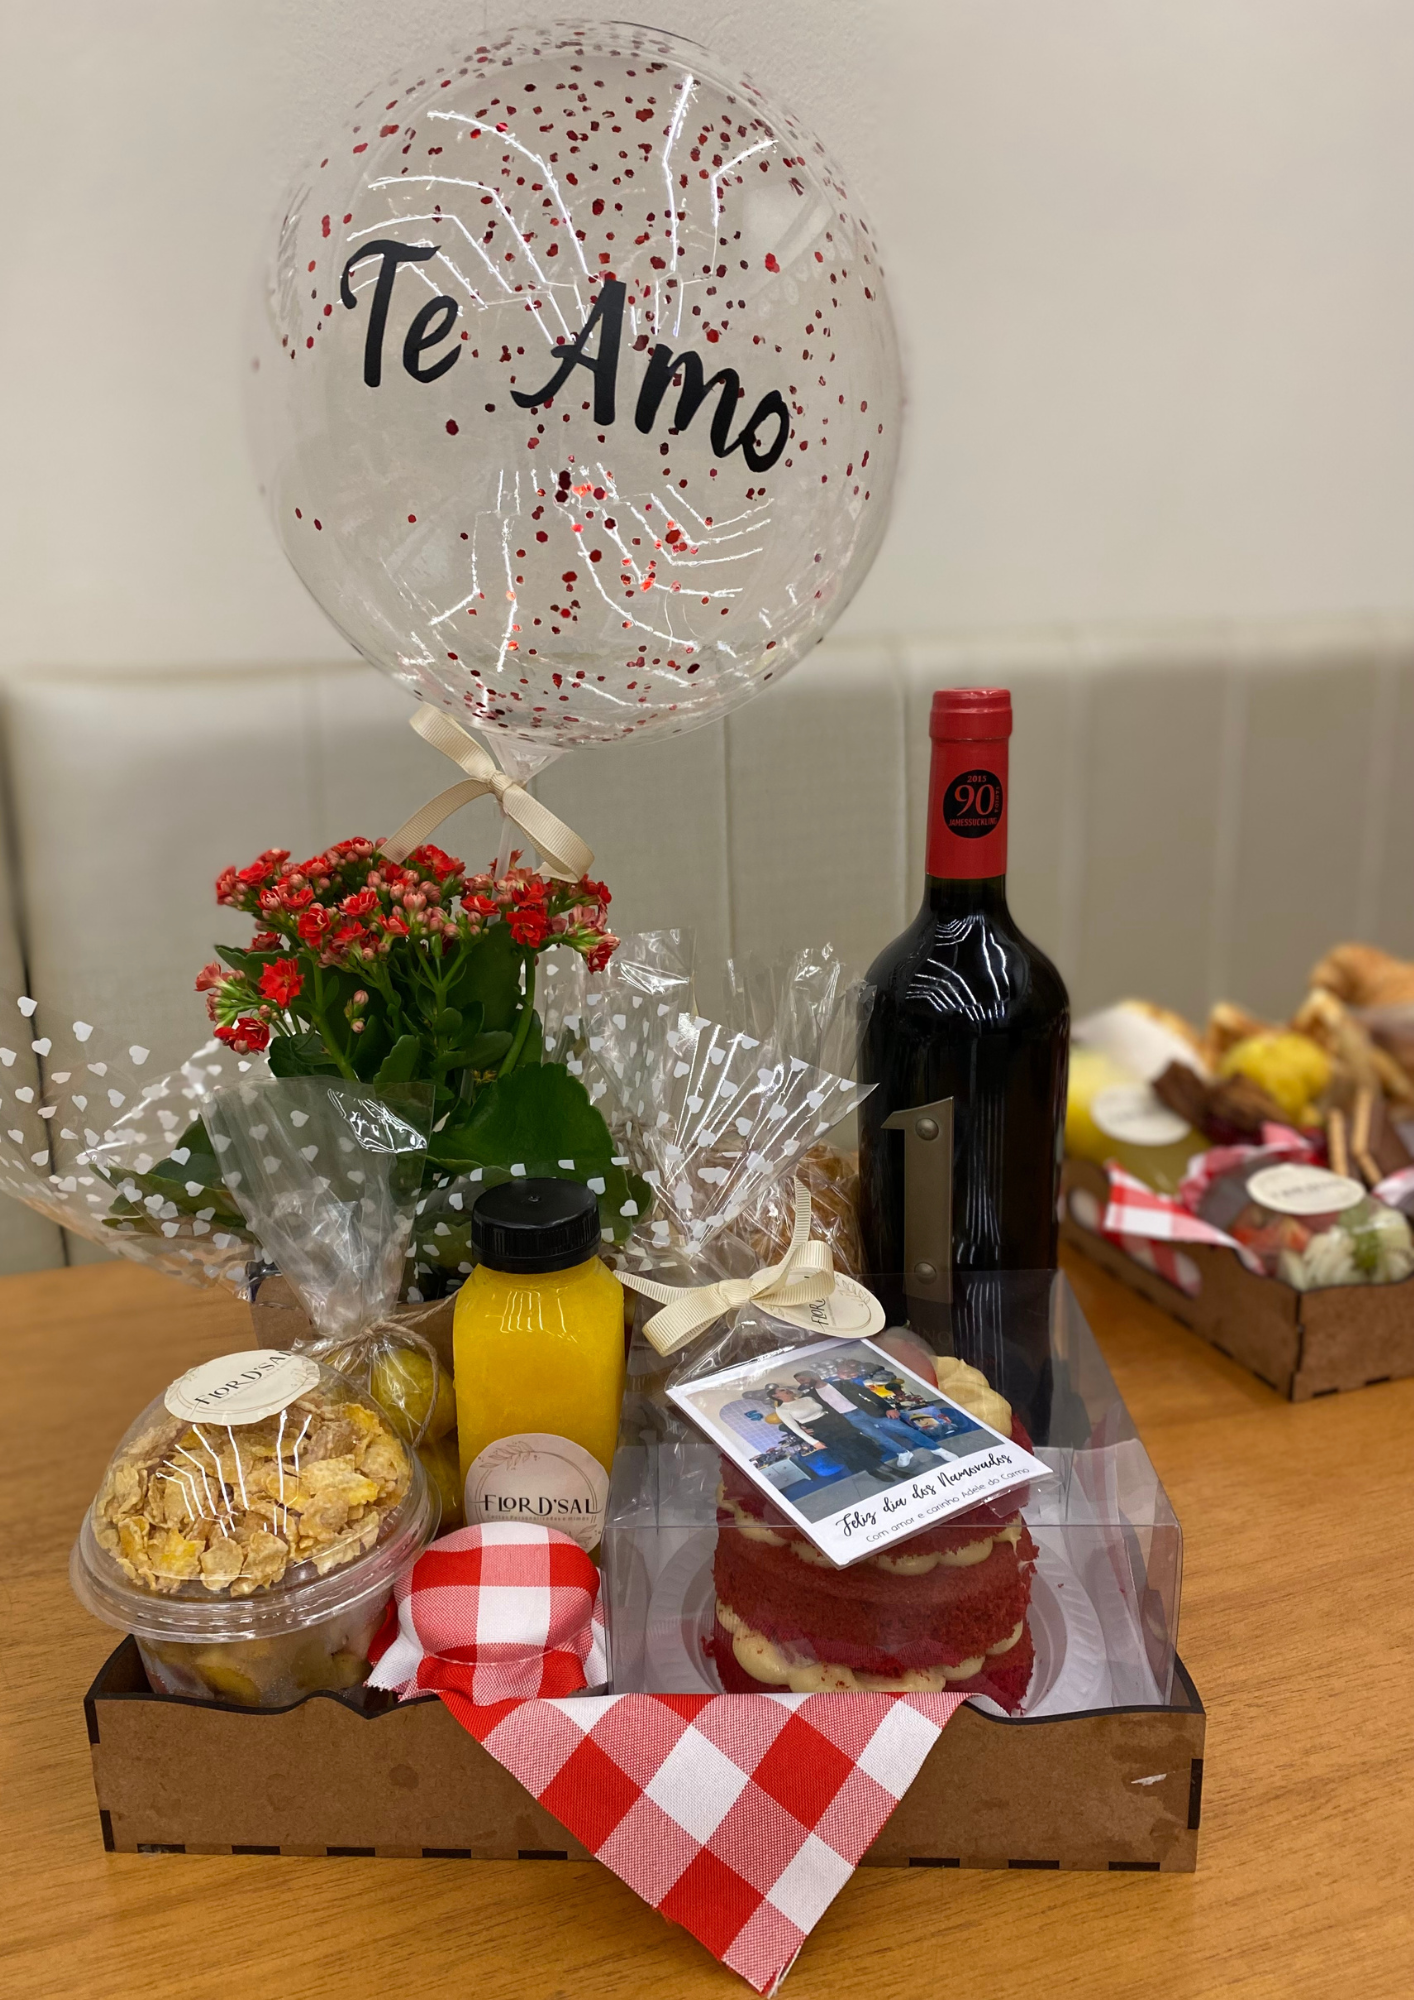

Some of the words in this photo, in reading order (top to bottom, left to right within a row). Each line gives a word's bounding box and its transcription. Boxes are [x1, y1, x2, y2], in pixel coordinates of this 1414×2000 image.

[340, 239, 462, 388] Te
[510, 279, 790, 474] Amo
[955, 784, 994, 816] 90
[967, 775, 987, 783] 2015
[538, 1496, 601, 1515] D'SAL
[836, 1509, 877, 1537] Feliz
[883, 1496, 907, 1514] dia
[912, 1483, 937, 1499] dos
[937, 1452, 1013, 1488] Namorados
[866, 1529, 889, 1543] Com
[891, 1517, 915, 1532] amor
[926, 1496, 960, 1515] carinho
[962, 1484, 986, 1499] Adele
[988, 1477, 1000, 1487] do
[1001, 1467, 1030, 1482] Carmo
